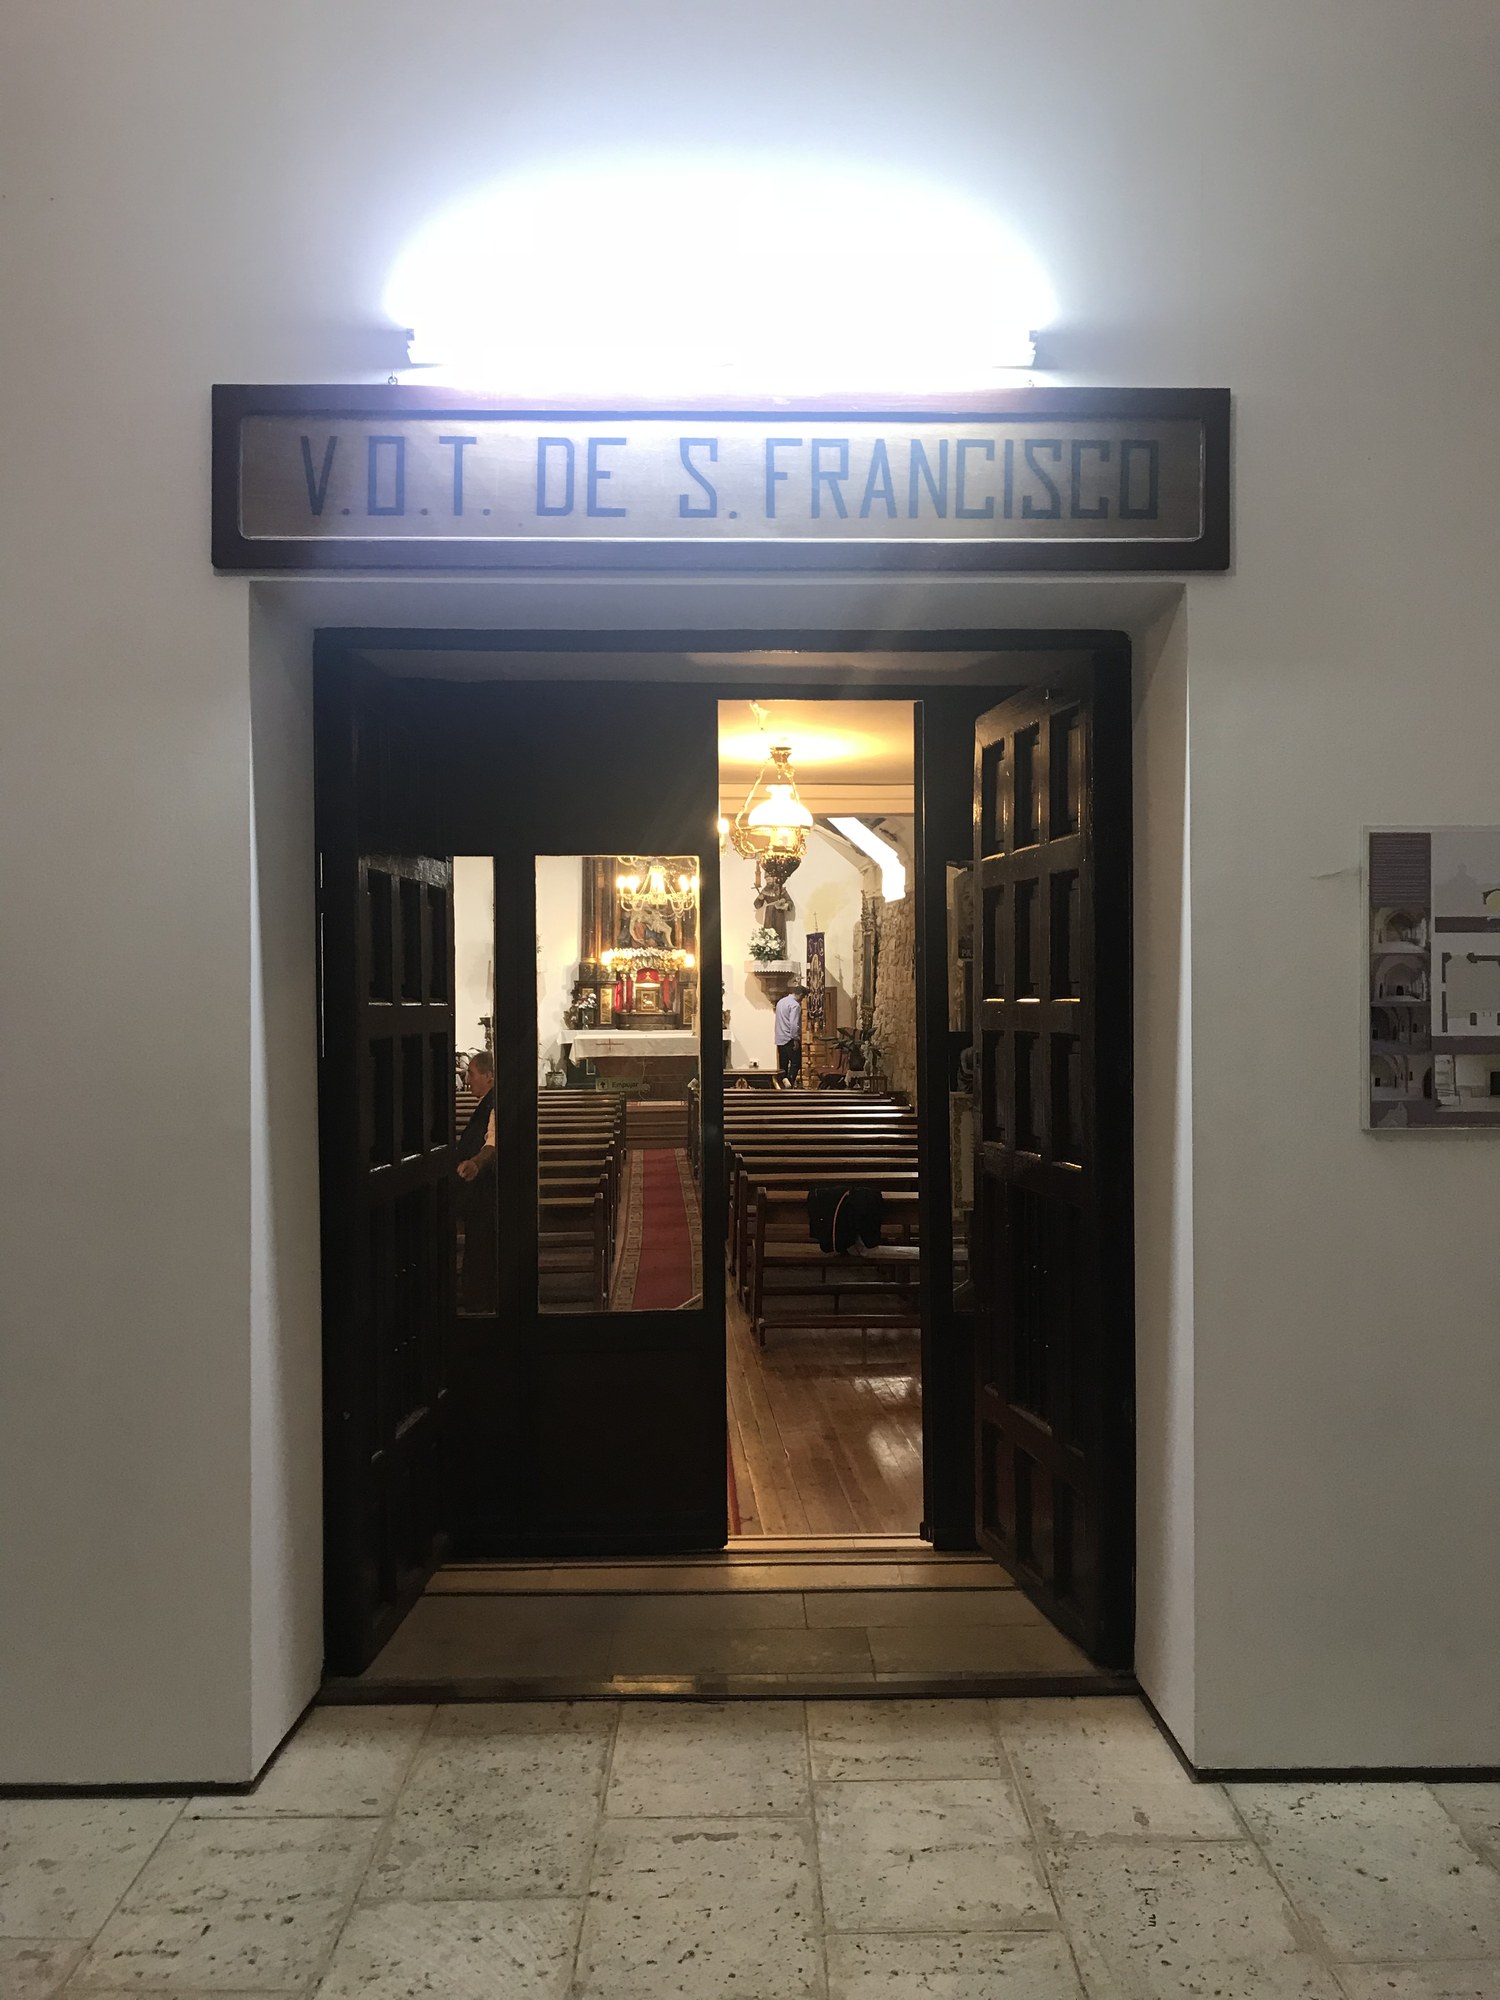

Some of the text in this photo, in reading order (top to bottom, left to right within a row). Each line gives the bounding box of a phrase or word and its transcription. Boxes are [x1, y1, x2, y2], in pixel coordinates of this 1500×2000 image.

[300, 435, 1160, 520] V.O.T. DE S. FRANCISCO
[611, 1081, 639, 1089] Empujar
